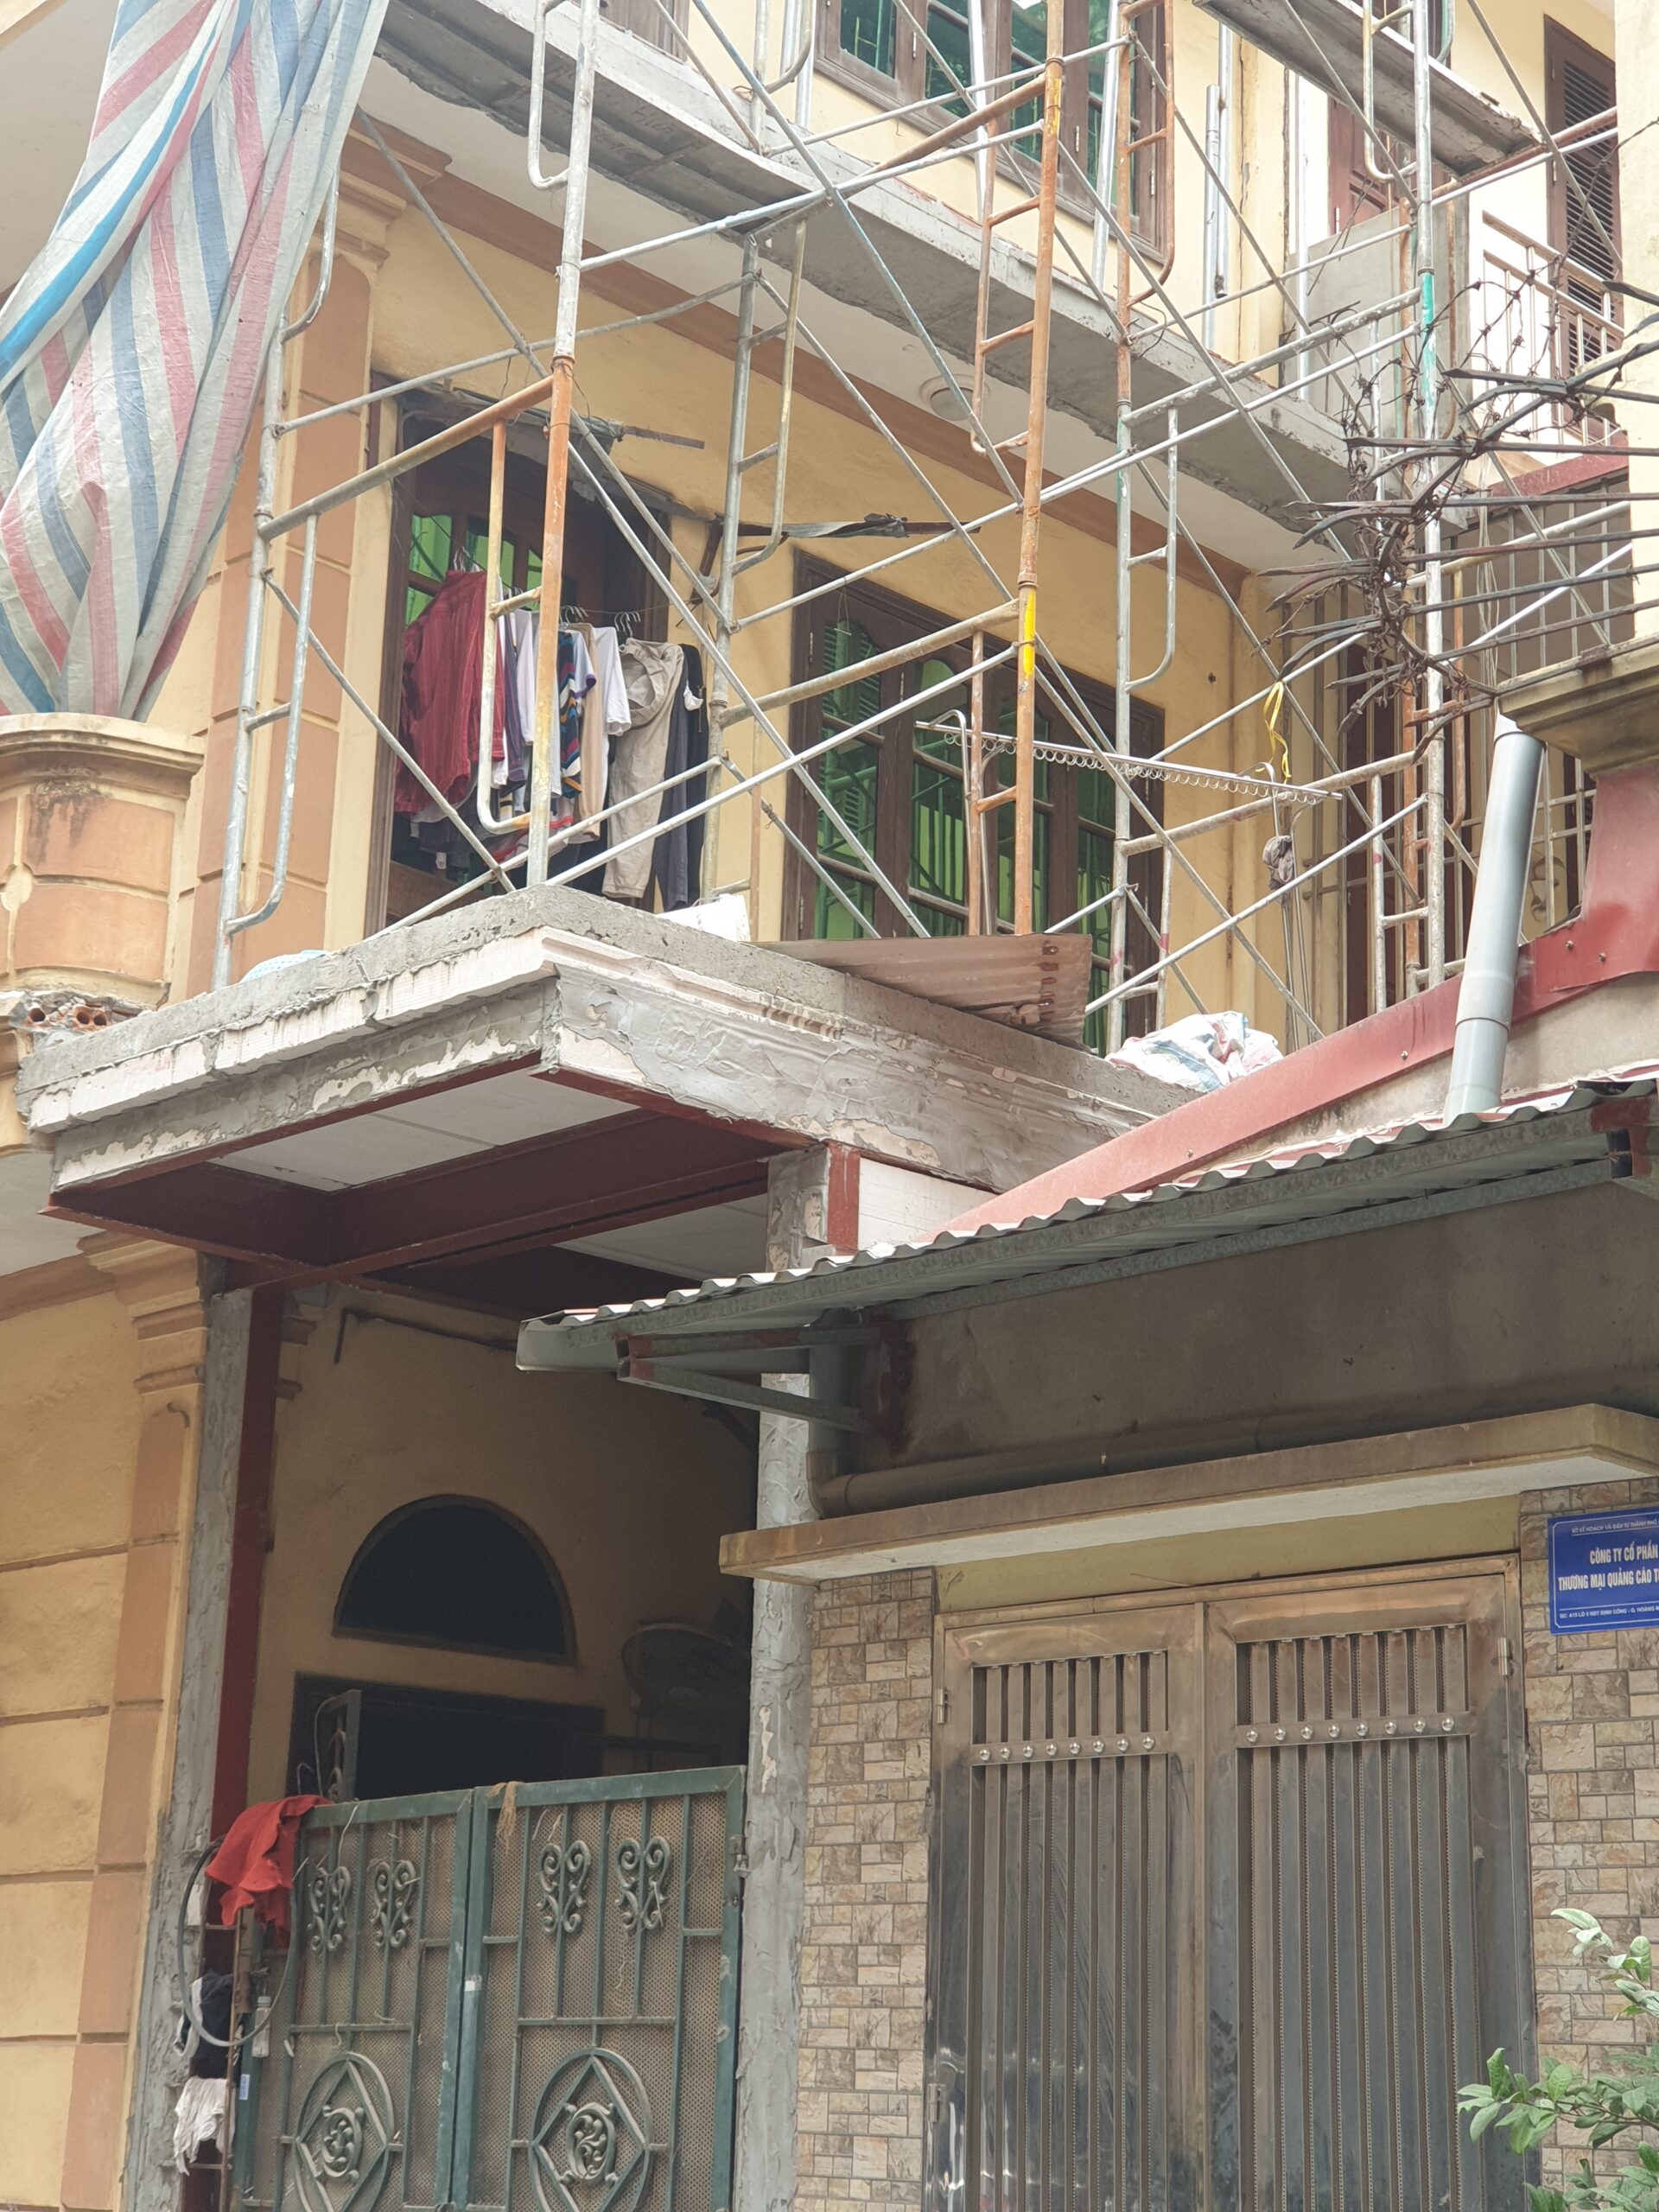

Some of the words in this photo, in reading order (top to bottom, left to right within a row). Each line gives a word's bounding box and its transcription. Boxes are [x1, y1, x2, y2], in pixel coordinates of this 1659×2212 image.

[1590, 1547, 1611, 1565] CÔNG
[1612, 1548, 1622, 1562] TY
[1590, 1573, 1605, 1591] MẠI
[1607, 1567, 1634, 1589] QUẢNG
[1636, 1566, 1651, 1584] CÁO
